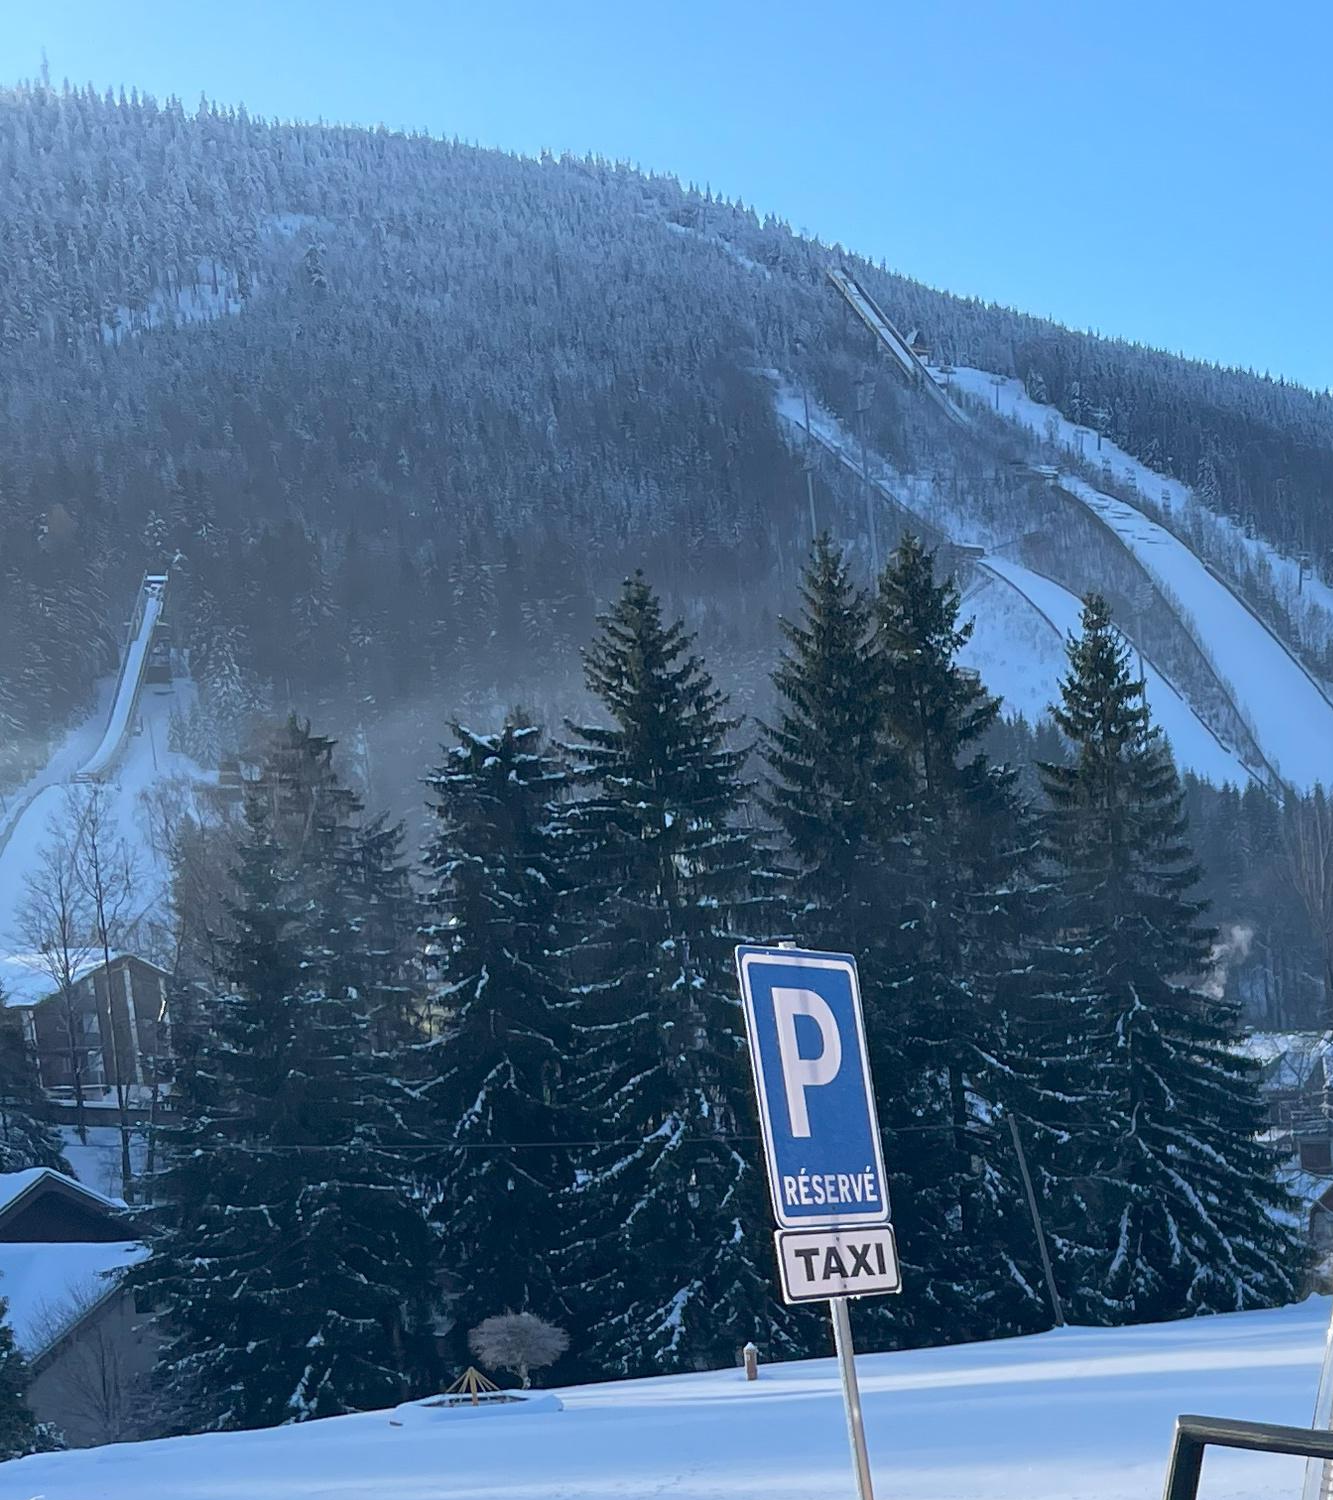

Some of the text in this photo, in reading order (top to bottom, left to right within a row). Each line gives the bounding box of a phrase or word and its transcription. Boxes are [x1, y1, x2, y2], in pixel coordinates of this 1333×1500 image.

[771, 986, 842, 1137] P
[783, 1166, 879, 1206] RÉSERVÉ
[794, 1242, 887, 1283] TAXI
